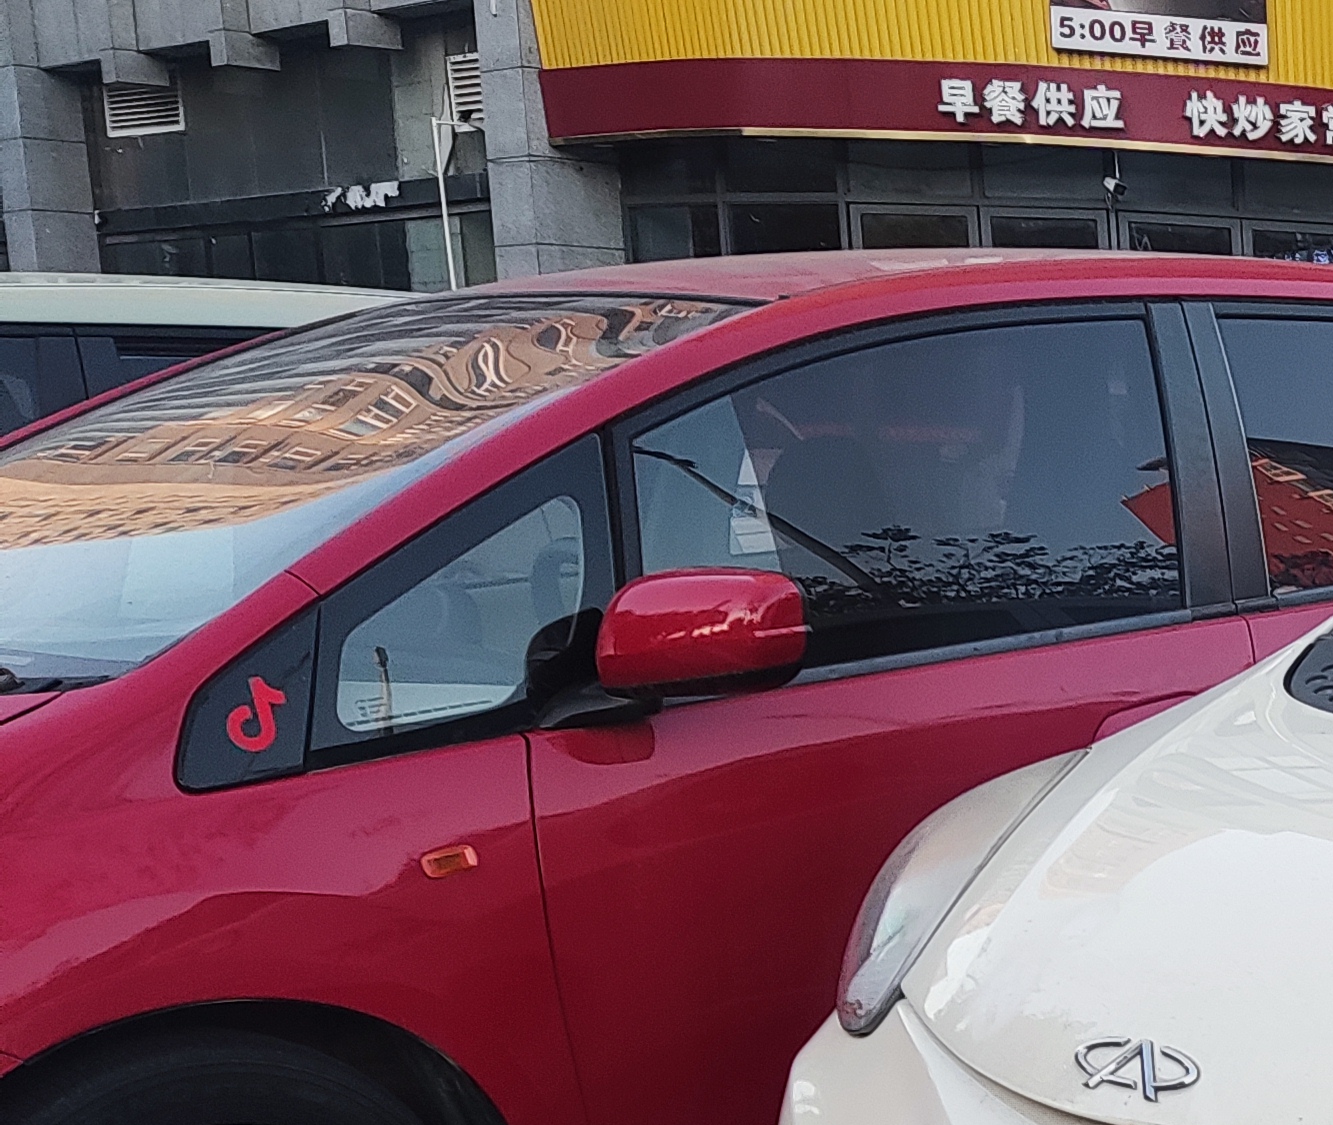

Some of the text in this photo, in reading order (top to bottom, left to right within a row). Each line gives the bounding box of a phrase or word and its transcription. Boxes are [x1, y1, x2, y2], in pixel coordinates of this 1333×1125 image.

[1059, 16, 1262, 57] 5:00早餐供应
[937, 79, 1125, 130] 早餐供应
